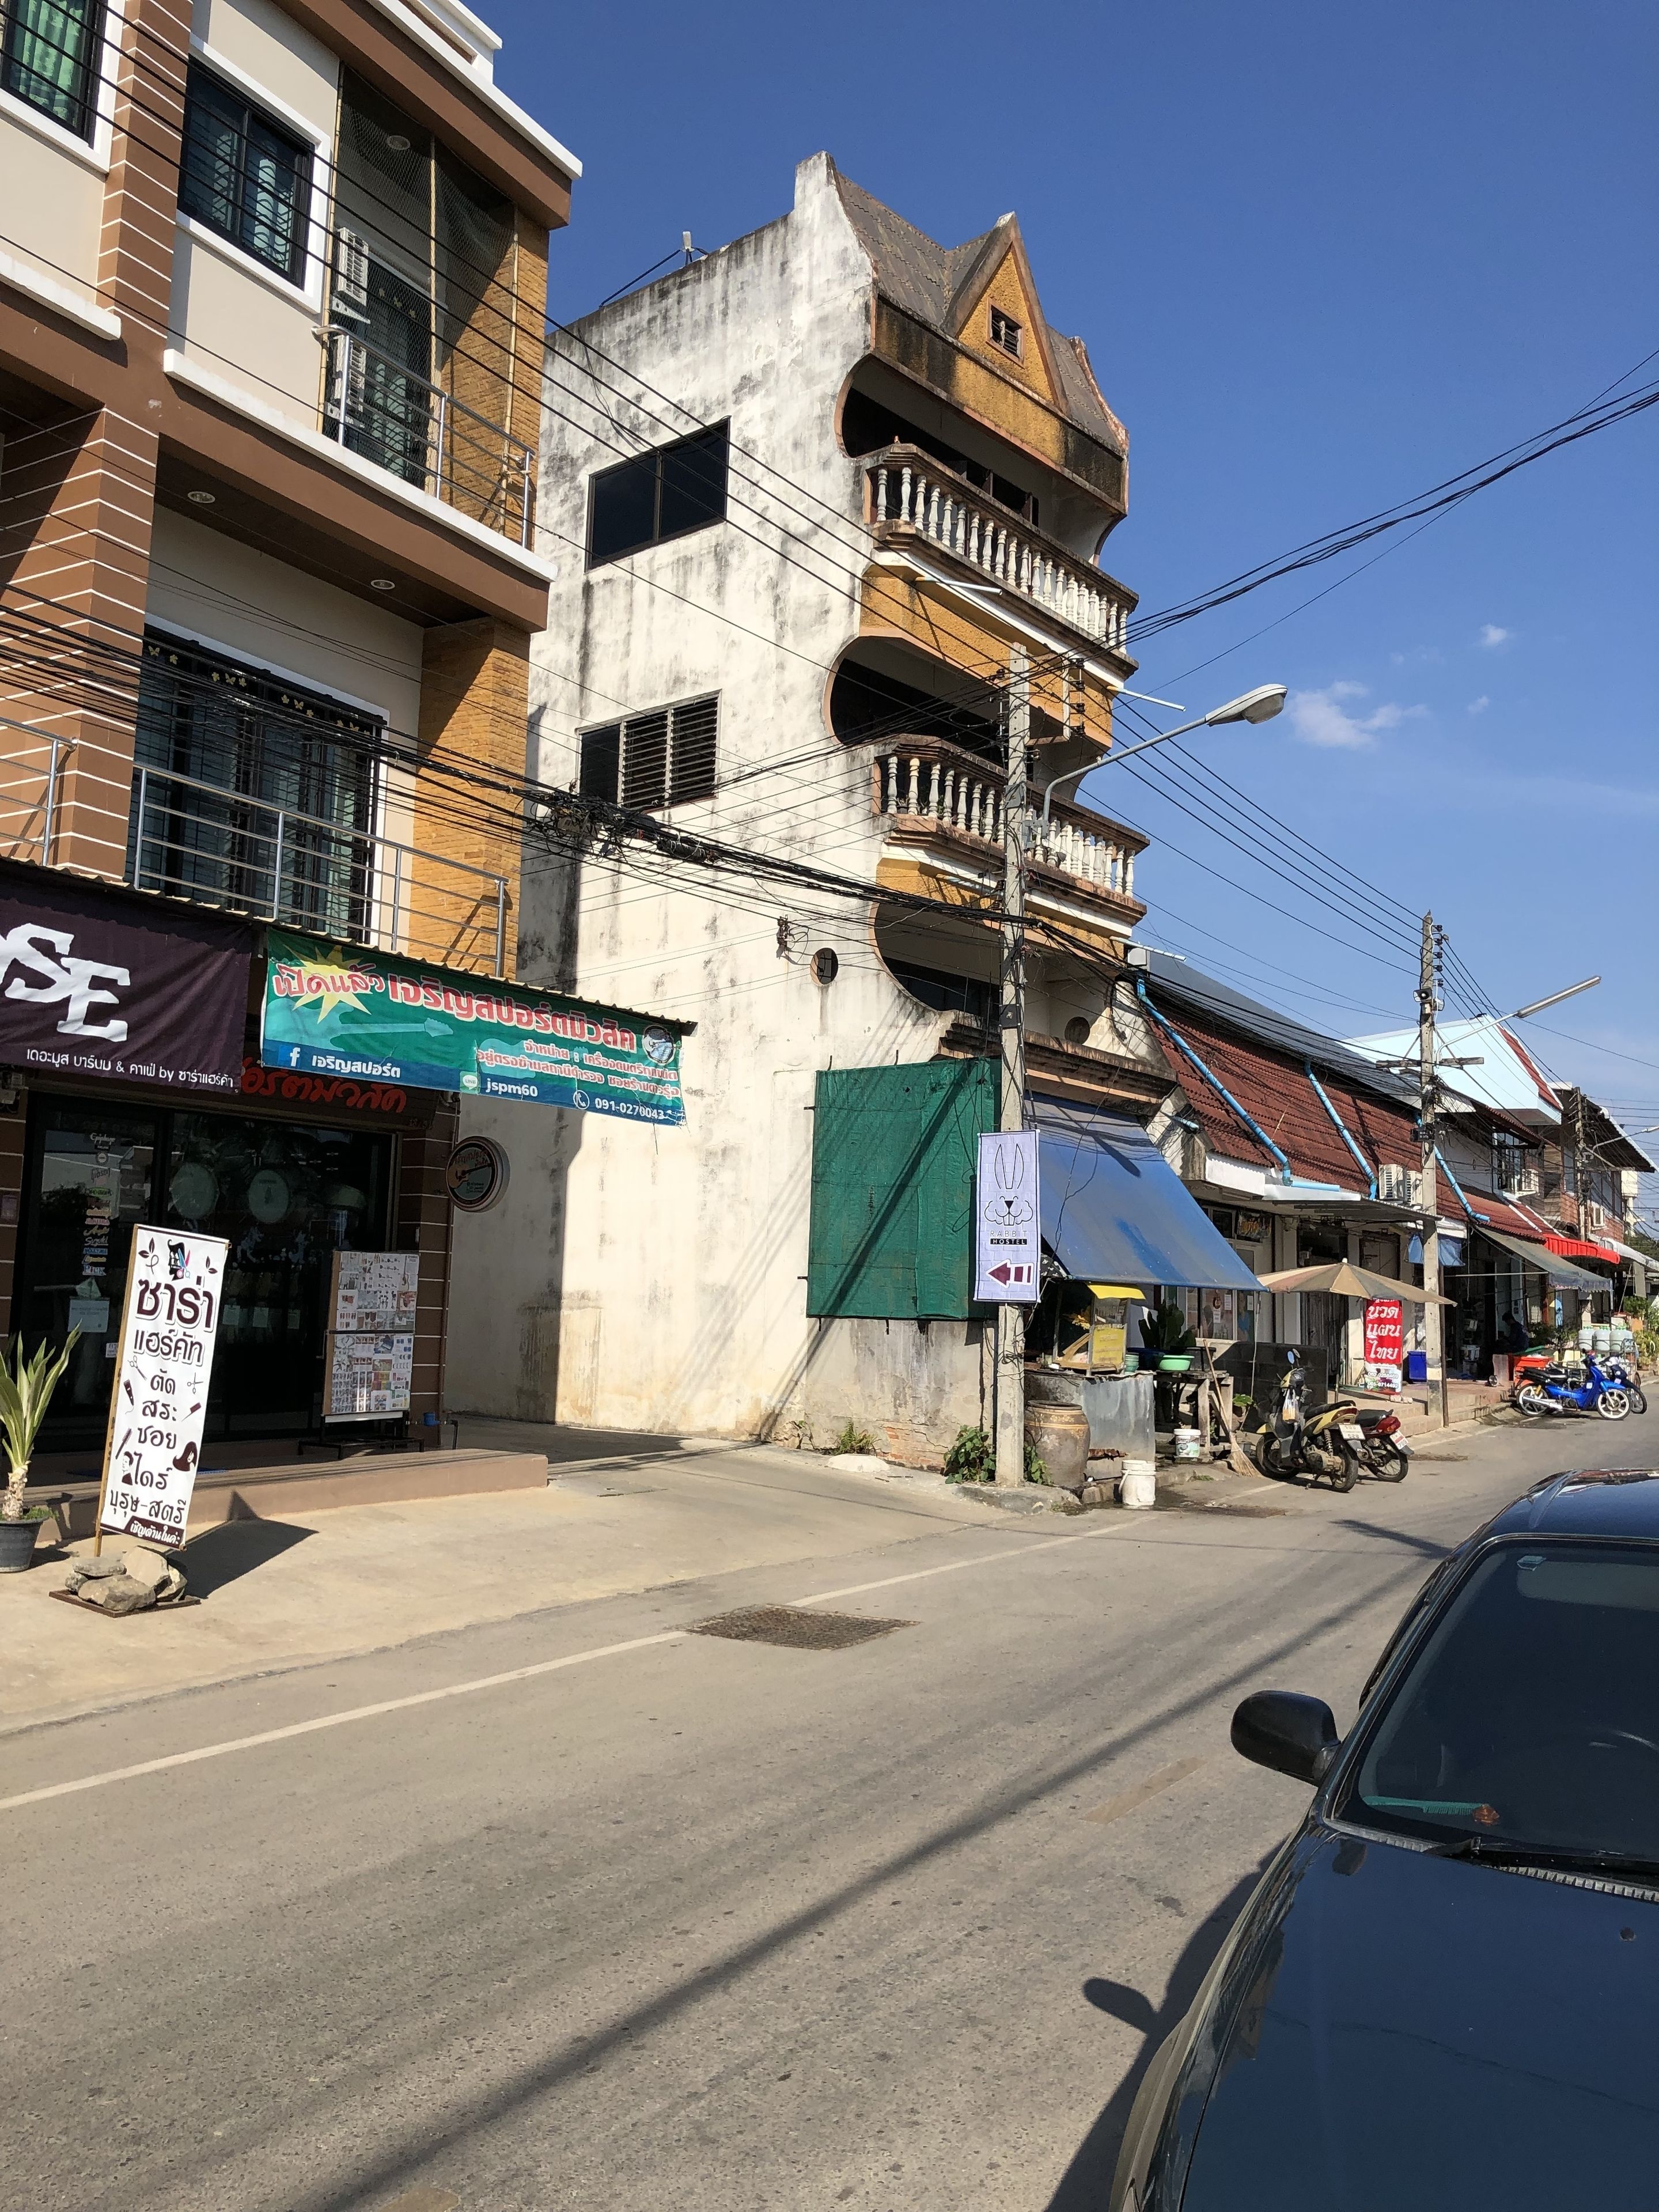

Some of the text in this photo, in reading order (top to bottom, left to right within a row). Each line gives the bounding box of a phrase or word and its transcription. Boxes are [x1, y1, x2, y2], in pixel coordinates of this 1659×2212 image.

[272, 963, 385, 997] เปิดแล้ว
[387, 972, 638, 1053] เจริญสปอร์ตมิวสิค
[524, 1039, 570, 1061] จำหน่าย
[26, 1048, 70, 1067] เดอะมูส
[73, 1055, 112, 1071] บาร์นม
[116, 1060, 125, 1073] &
[159, 1066, 174, 1082] by
[312, 1054, 402, 1078] เจริญสปอร์ต
[464, 1077, 476, 1085] LINE
[485, 1078, 538, 1097] jspm60
[594, 1097, 665, 1120] 091-0270043
[137, 1276, 215, 1330] ซาร่า
[1368, 1306, 1399, 1319] นวด
[1366, 1324, 1402, 1338] แผน
[134, 1328, 204, 1363] แฮร์คัท
[1368, 1339, 1399, 1360] ไทย
[150, 1368, 176, 1395] ตัด
[142, 1400, 177, 1422] สระ
[134, 1451, 173, 1490] ไดร์
[110, 1489, 187, 1524] บุรุษ-สตรี
